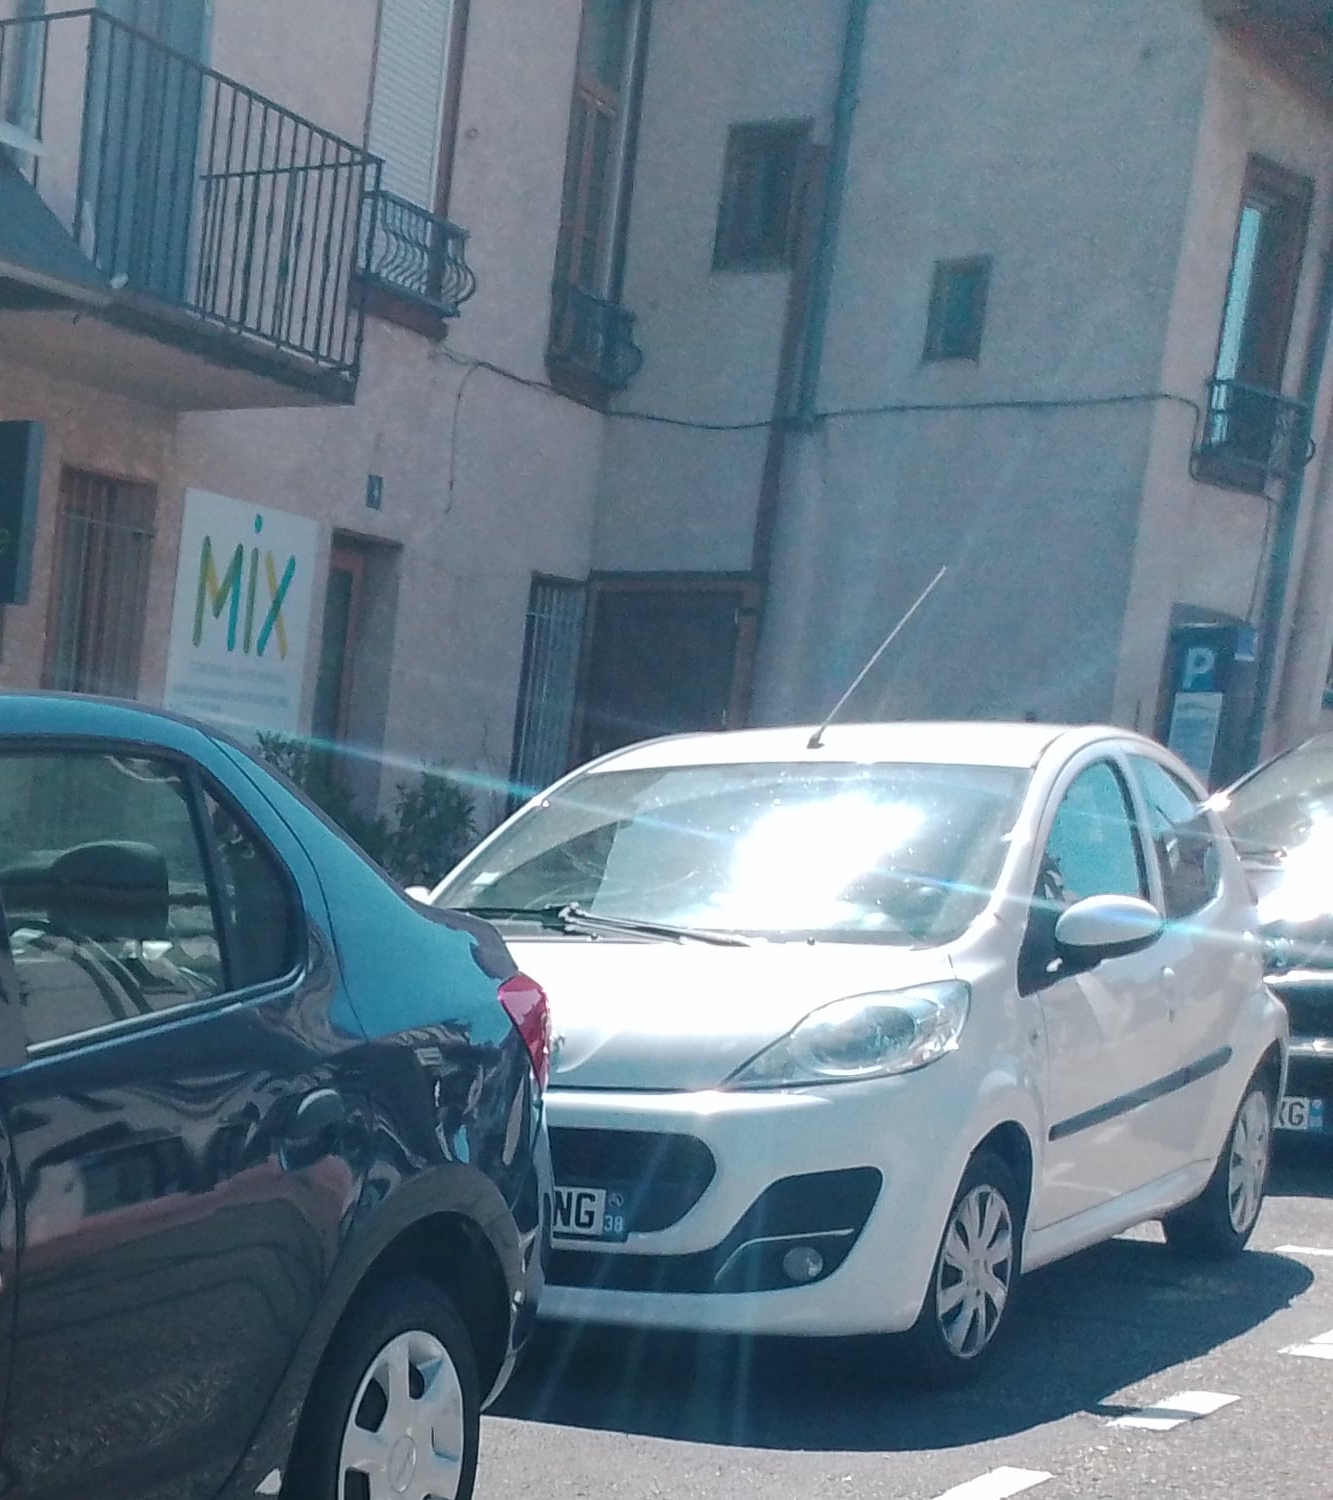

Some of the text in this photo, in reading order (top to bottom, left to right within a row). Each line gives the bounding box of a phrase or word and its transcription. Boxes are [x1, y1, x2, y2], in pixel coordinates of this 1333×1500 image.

[192, 514, 296, 660] MIX
[1182, 647, 1215, 690] P
[604, 1214, 624, 1234] 38
